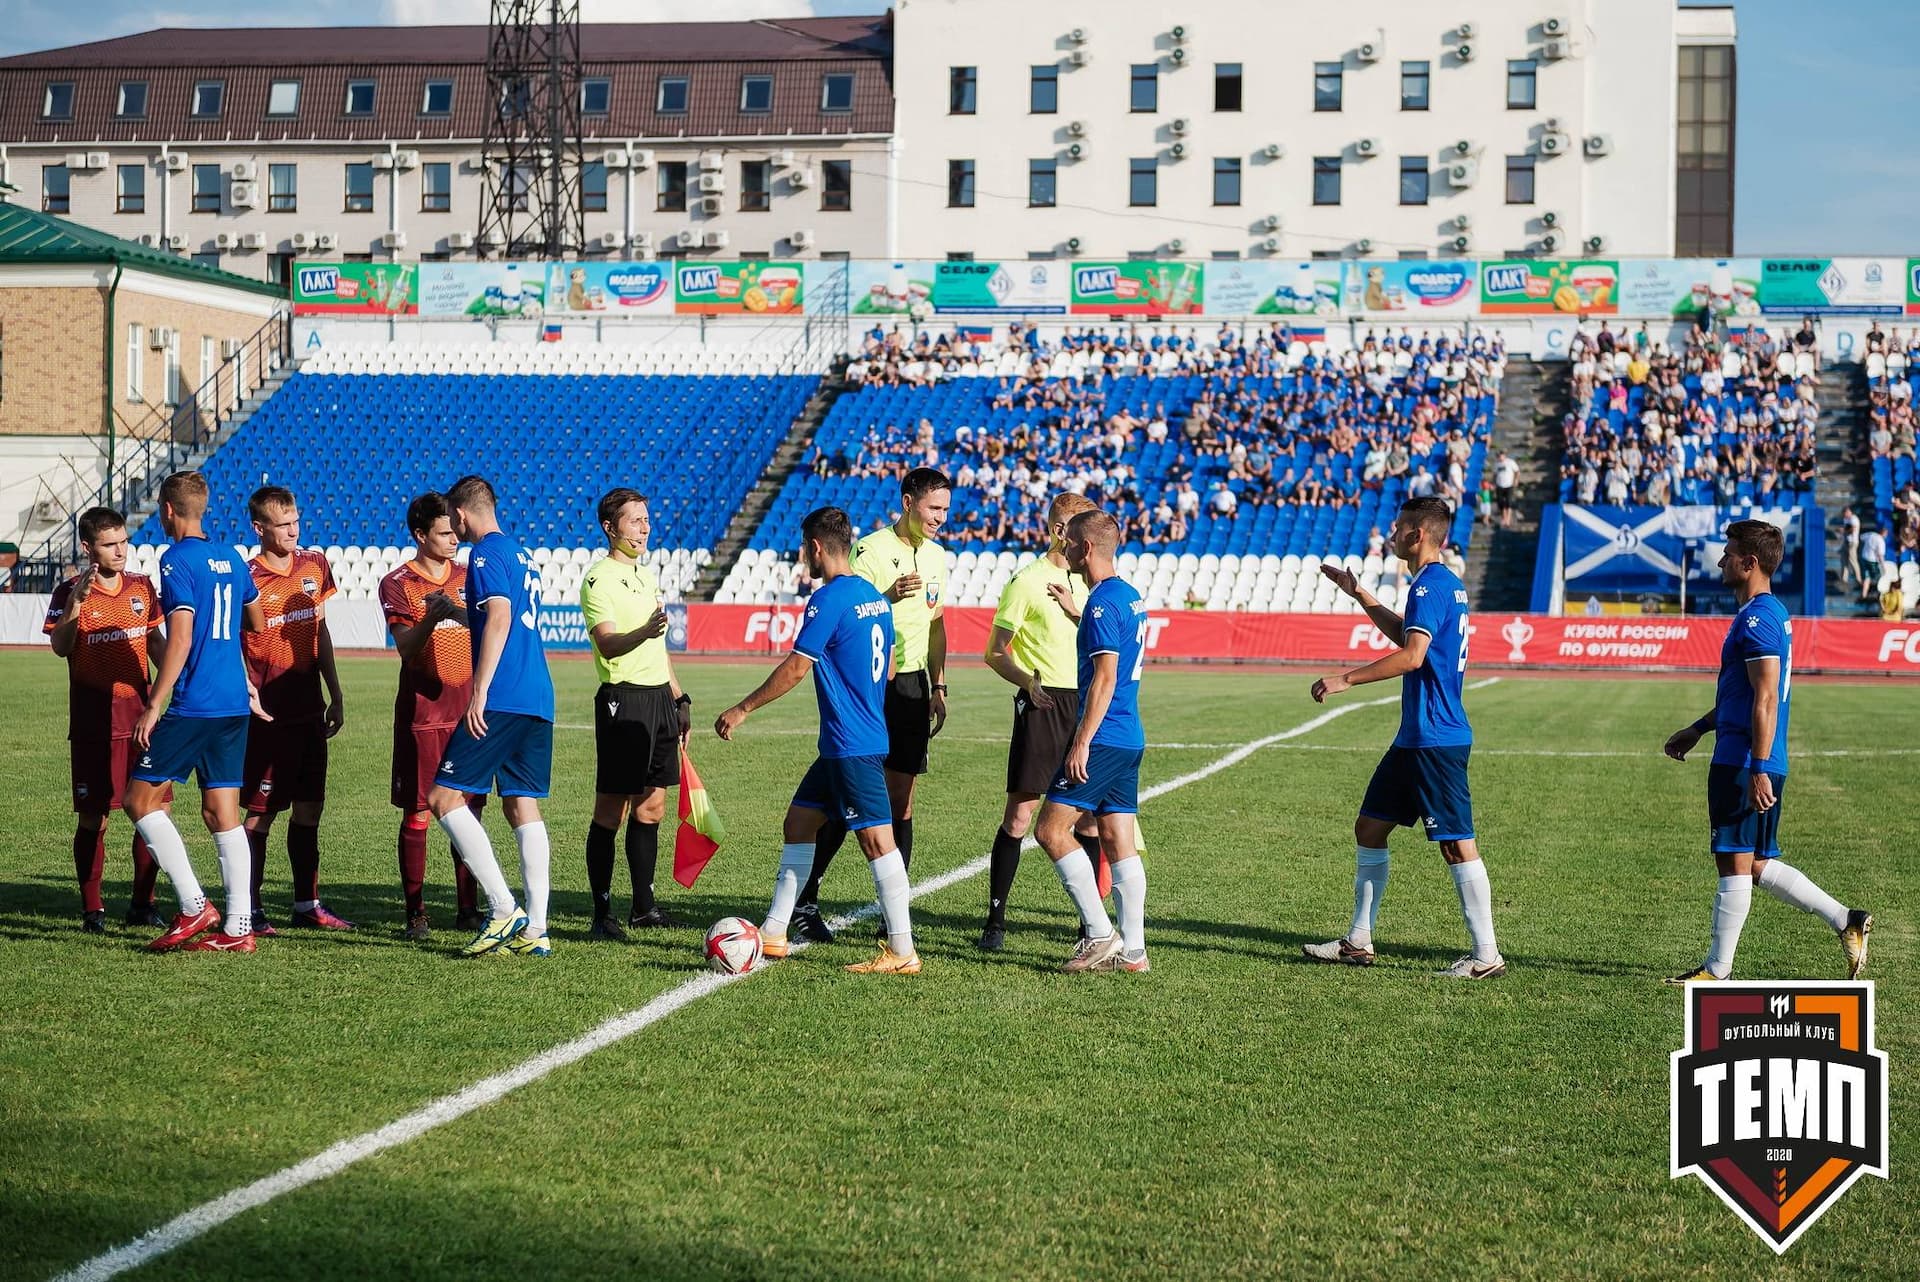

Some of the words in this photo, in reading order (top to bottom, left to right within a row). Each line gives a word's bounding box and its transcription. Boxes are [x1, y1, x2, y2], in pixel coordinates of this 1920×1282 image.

[304, 271, 338, 291] ЛАКТ
[684, 270, 719, 292] ЛАКТ
[1490, 269, 1526, 291] ЛАКТ
[307, 330, 322, 348] A
[1547, 329, 1563, 349] C
[212, 582, 232, 640] 11
[540, 611, 586, 628] АЦИЯ
[1564, 624, 1619, 639] КУБОК
[1622, 625, 1688, 640] РОССИИ
[871, 624, 885, 683] 8
[1559, 642, 1584, 656] ПО
[1586, 643, 1663, 657] ФУТБОЛУ
